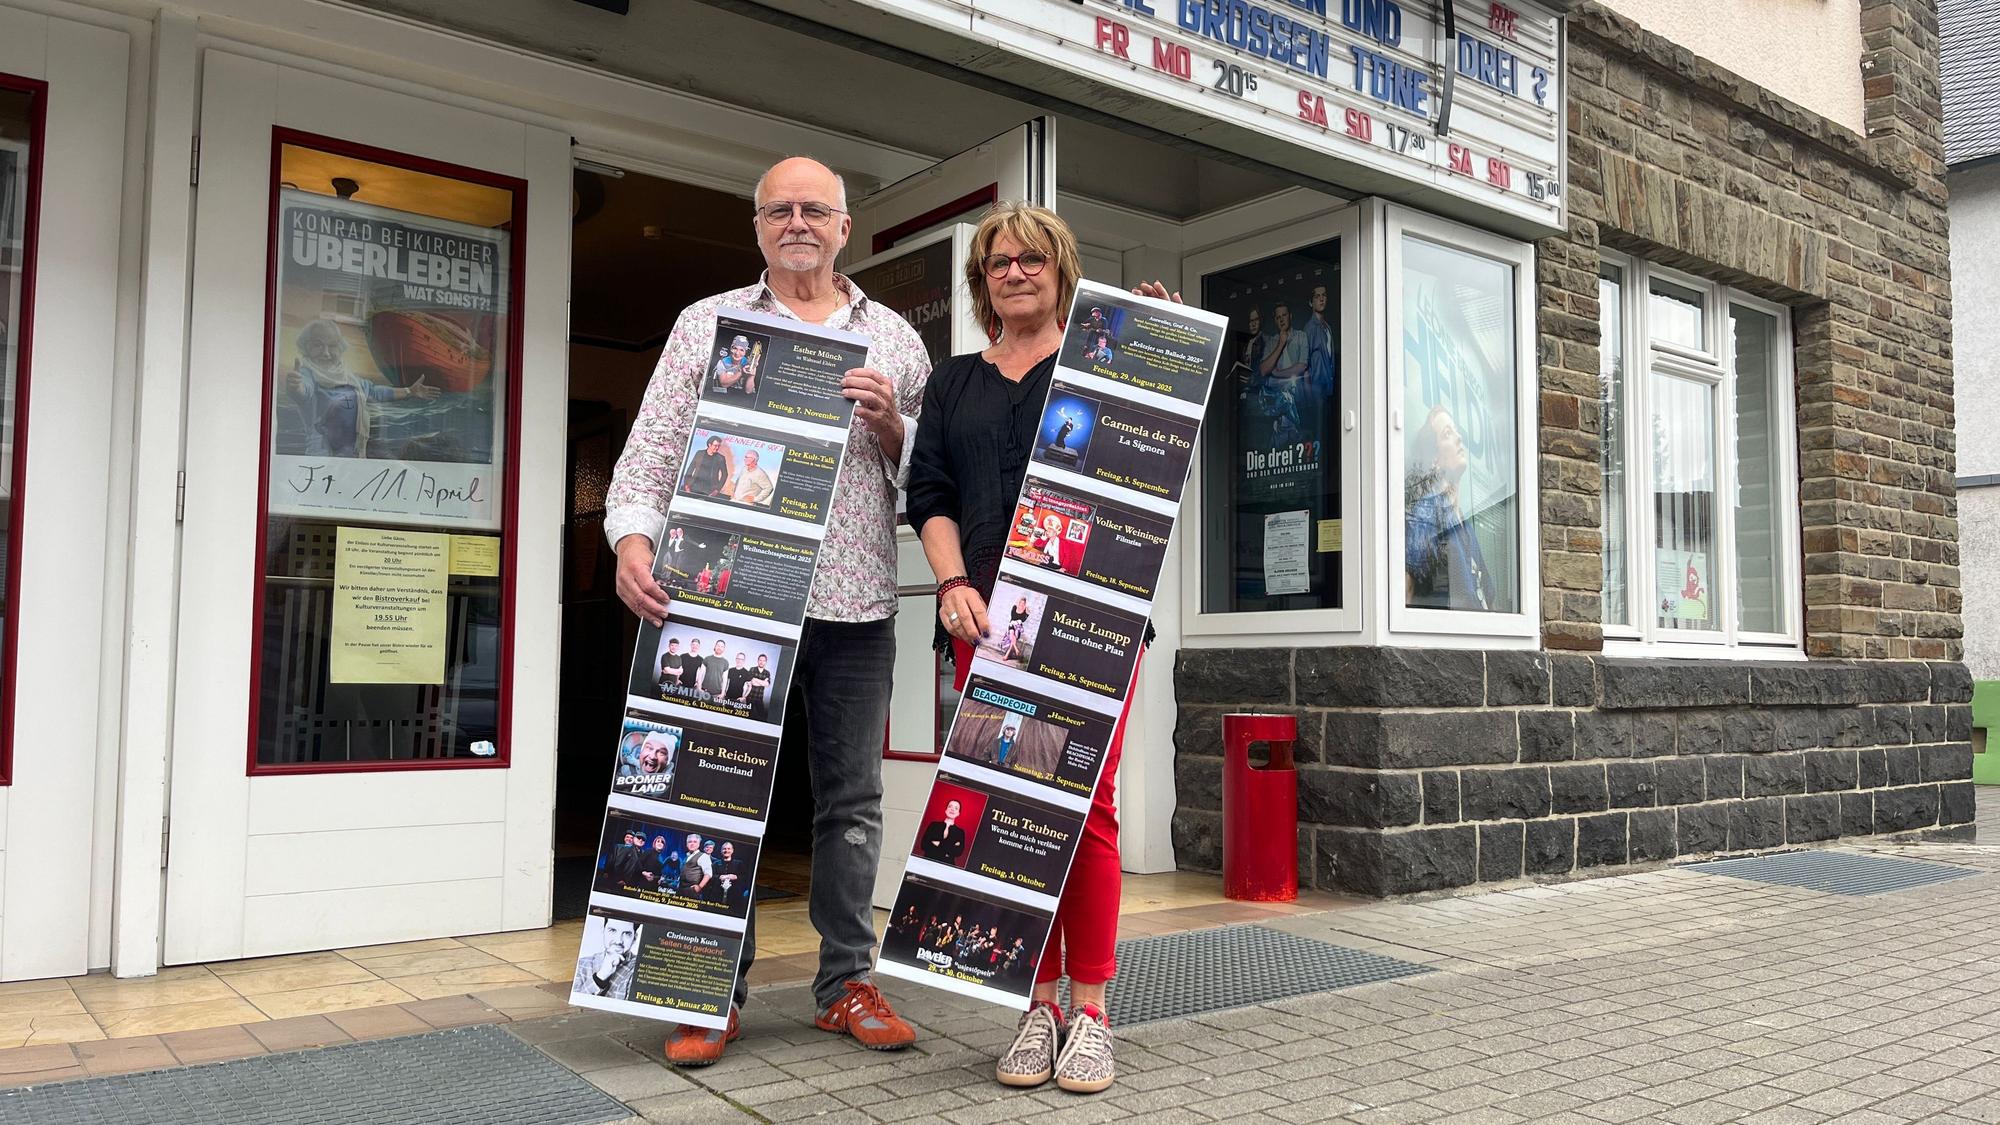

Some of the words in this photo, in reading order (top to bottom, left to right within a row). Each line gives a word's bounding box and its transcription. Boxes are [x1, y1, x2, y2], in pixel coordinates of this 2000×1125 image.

[1179, 0, 1330, 79] GROSSEN
[1096, 16, 1130, 60] FR
[1153, 37, 1192, 80] MO
[1297, 89, 1329, 129] SA
[1344, 106, 1372, 145] SO
[1458, 32, 1518, 96] DREI
[1531, 66, 1548, 107] ?
[1448, 143, 1474, 178] SA
[1488, 157, 1511, 190] SO
[292, 211, 373, 242] KONRAD
[381, 226, 493, 263] BEIKIRCHER
[292, 230, 493, 295] ÜBERLEBEN
[403, 284, 435, 303] WAT
[435, 288, 491, 311] SONST?!
[793, 345, 817, 358] Esther
[818, 349, 843, 362] Münch
[1092, 364, 1119, 380] Freitag,
[1119, 372, 1130, 382] 29.
[1131, 375, 1156, 389] August
[1157, 383, 1173, 393] 2025
[768, 401, 795, 415] Freitag,
[796, 406, 803, 415] 7.
[804, 408, 842, 422] November
[1101, 415, 1149, 438] Carmela
[1151, 429, 1166, 442] de
[1169, 433, 1191, 449] Feo
[788, 448, 802, 457] Der
[803, 451, 835, 465] Kult-Talk
[1118, 435, 1131, 446] La
[1132, 438, 1166, 456] Signora
[1246, 450, 1266, 471] Die
[1268, 444, 1293, 468] drei
[1296, 440, 1320, 463] ???
[417, 471, 484, 508] April
[1096, 467, 1123, 483] Freitag,
[1124, 475, 1131, 483] 5.
[1132, 478, 1170, 495] September
[780, 506, 817, 520] November
[781, 496, 809, 509] Freitag,
[810, 502, 819, 511] 14.
[1095, 515, 1124, 532] Volker
[1124, 524, 1169, 545] Weininger
[798, 554, 812, 563] 2025
[1085, 570, 1109, 583] Freitag,
[1118, 579, 1150, 595] September
[355, 604, 417, 612] Kulturveranstaltungen
[374, 594, 421, 604] Bistroverkauf
[678, 591, 722, 607] Donnerstag,
[723, 600, 734, 609] 27.
[735, 602, 774, 617] November
[374, 614, 393, 622] 19.55
[394, 615, 408, 623] Uhr
[1052, 611, 1087, 631] Marie
[1088, 622, 1132, 647] Lumpp
[1051, 627, 1080, 643] Mama
[1081, 636, 1104, 651] ohne
[1105, 644, 1124, 657] Plan
[1039, 663, 1066, 680] Freitag,
[1067, 672, 1078, 682] 26.
[1079, 676, 1117, 694] September
[661, 693, 691, 706] Samstag,
[692, 699, 699, 707] 6.
[700, 701, 734, 715] Dezember
[735, 708, 750, 717] 2025
[713, 697, 752, 710] unplugged
[973, 688, 1036, 714] BEACHPEOPLE
[688, 740, 715, 756] Lars
[718, 746, 769, 767] Reichow
[616, 774, 672, 786] BOOMER
[698, 758, 753, 777] Boomerland
[1013, 763, 1044, 779] Samstag,
[1044, 772, 1055, 781] 27.
[1056, 776, 1092, 792] September
[631, 783, 667, 793] LAND
[680, 793, 717, 807] Donnerstag,
[718, 800, 726, 808] 12.
[727, 802, 759, 815] Dezember
[991, 808, 1019, 827] Tina
[1022, 818, 1070, 841] Teubner
[991, 824, 1009, 836] Wenn
[1009, 829, 1019, 838] du
[1019, 833, 1036, 844] mich
[998, 836, 1023, 850] komme
[1023, 843, 1034, 853] ich
[1034, 847, 1047, 856] mit
[980, 863, 1008, 879] Freitag,
[1008, 871, 1016, 880] 3.
[1016, 873, 1046, 889] Oktober
[639, 893, 661, 903] Freitag,
[667, 898, 686, 908] Januar
[686, 901, 699, 910] 2026
[666, 931, 700, 945] Christoph
[700, 937, 719, 947] Kuch
[956, 971, 984, 985] Oktober
[635, 992, 664, 1005] Freitag,
[664, 997, 676, 1006] 30.
[676, 998, 701, 1011] Januar
[701, 1003, 718, 1013] 2026
